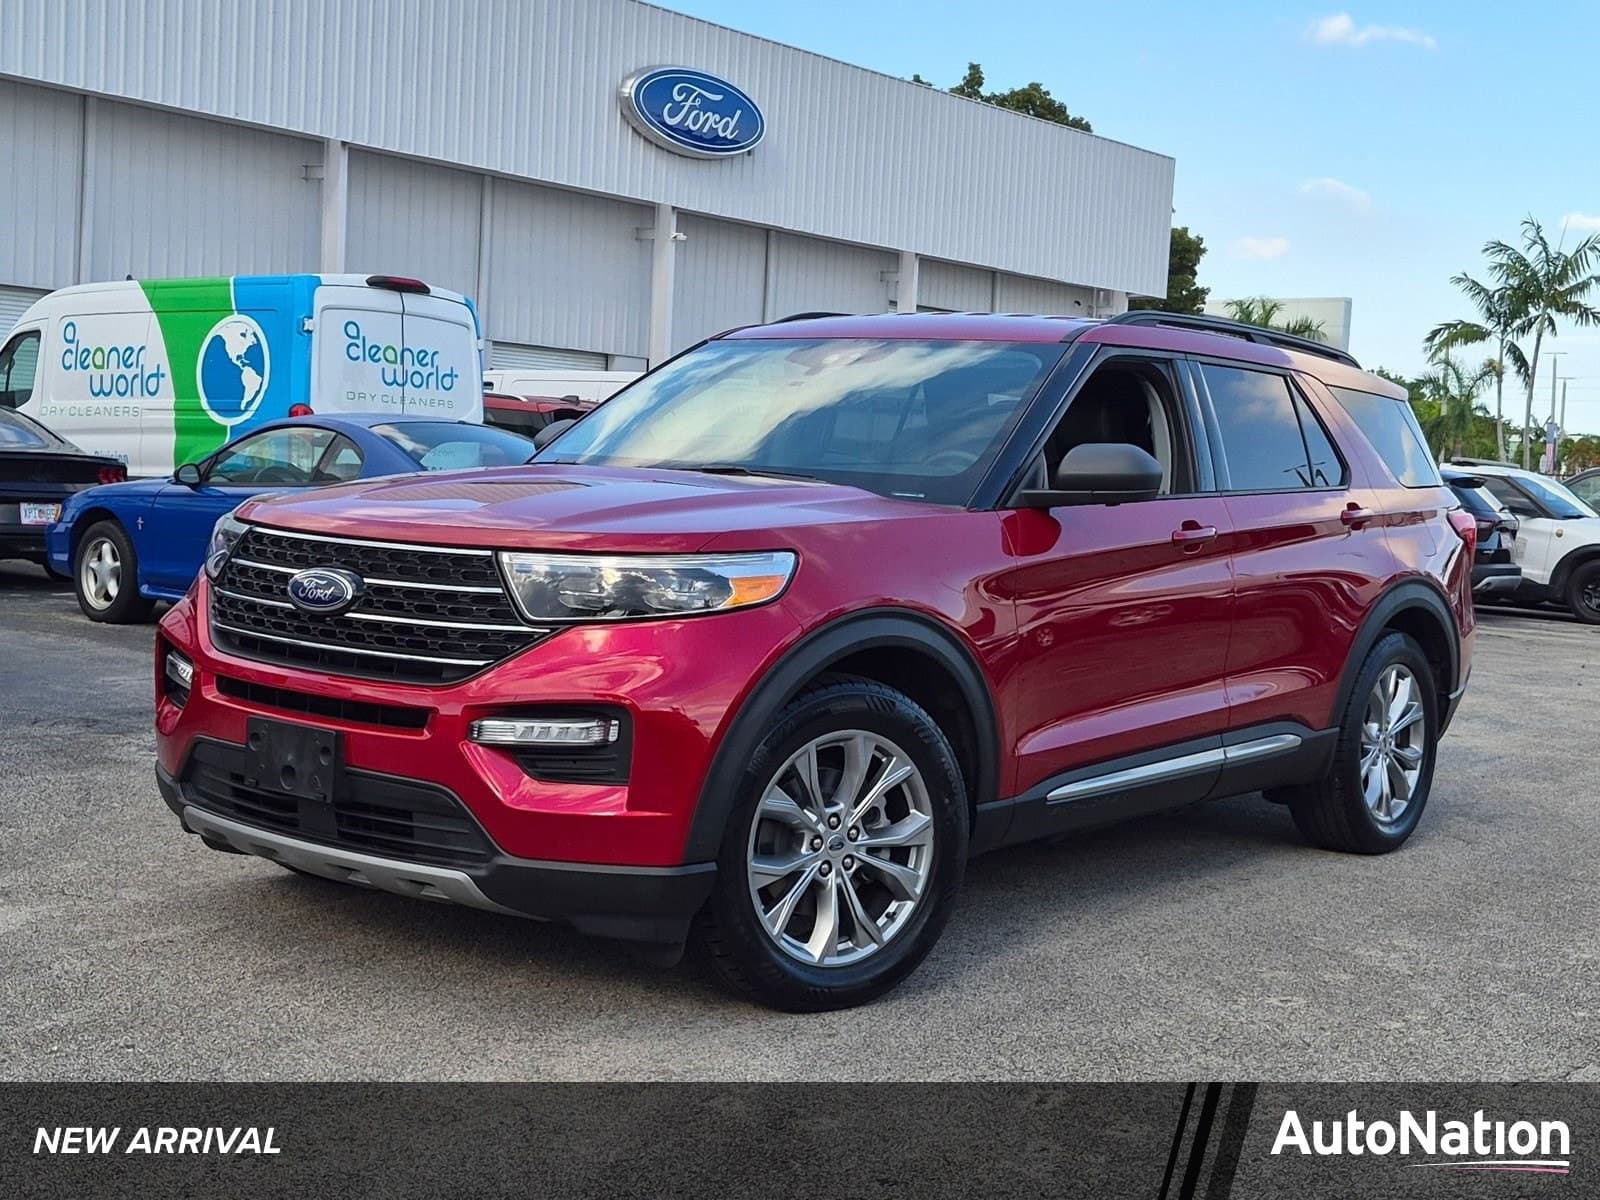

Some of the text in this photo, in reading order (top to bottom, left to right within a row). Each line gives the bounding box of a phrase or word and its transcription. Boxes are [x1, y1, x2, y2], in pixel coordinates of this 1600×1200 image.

[663, 82, 742, 140] Ford
[63, 321, 76, 344] a
[344, 320, 360, 340] a
[61, 339, 146, 371] cleaner
[346, 335, 439, 368] cleaner
[89, 363, 165, 397] world
[381, 365, 459, 391] world
[40, 406, 140, 417] DRY CLEANERS
[346, 391, 454, 409] DRY CLEANERS
[298, 577, 336, 601] Ford
